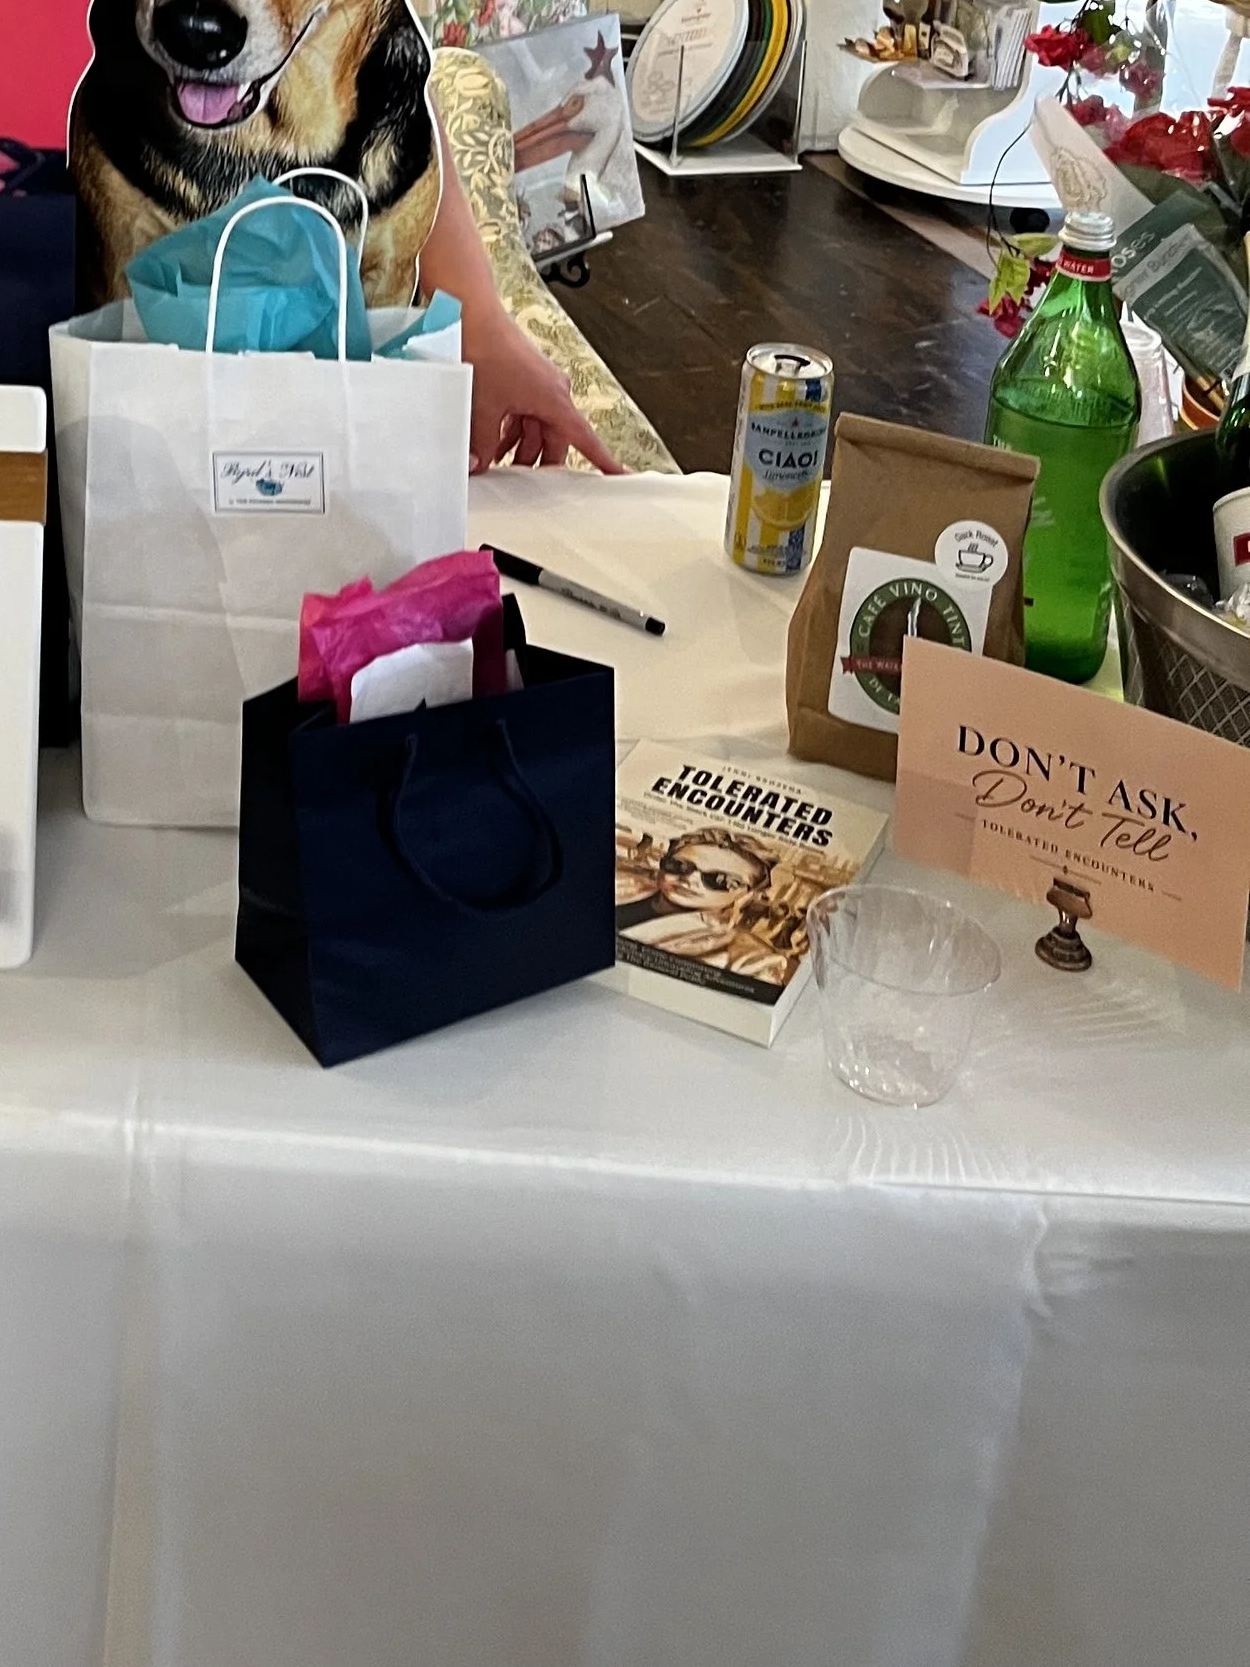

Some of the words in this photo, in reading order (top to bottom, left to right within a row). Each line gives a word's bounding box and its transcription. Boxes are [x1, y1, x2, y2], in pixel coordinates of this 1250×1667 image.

[758, 448, 818, 470] CIAO!
[889, 582, 938, 603] VINO
[942, 605, 967, 648] TINT
[651, 777, 834, 847] ENCOUNTERS
[677, 764, 834, 826] TOLERATED
[957, 725, 1096, 796] DON'T
[1108, 779, 1198, 842] ASK,
[972, 769, 1093, 830] Don't
[1100, 812, 1172, 862] Tell
[981, 819, 1059, 855] TOLERATED
[1064, 849, 1155, 891] ENCOUNTERS
